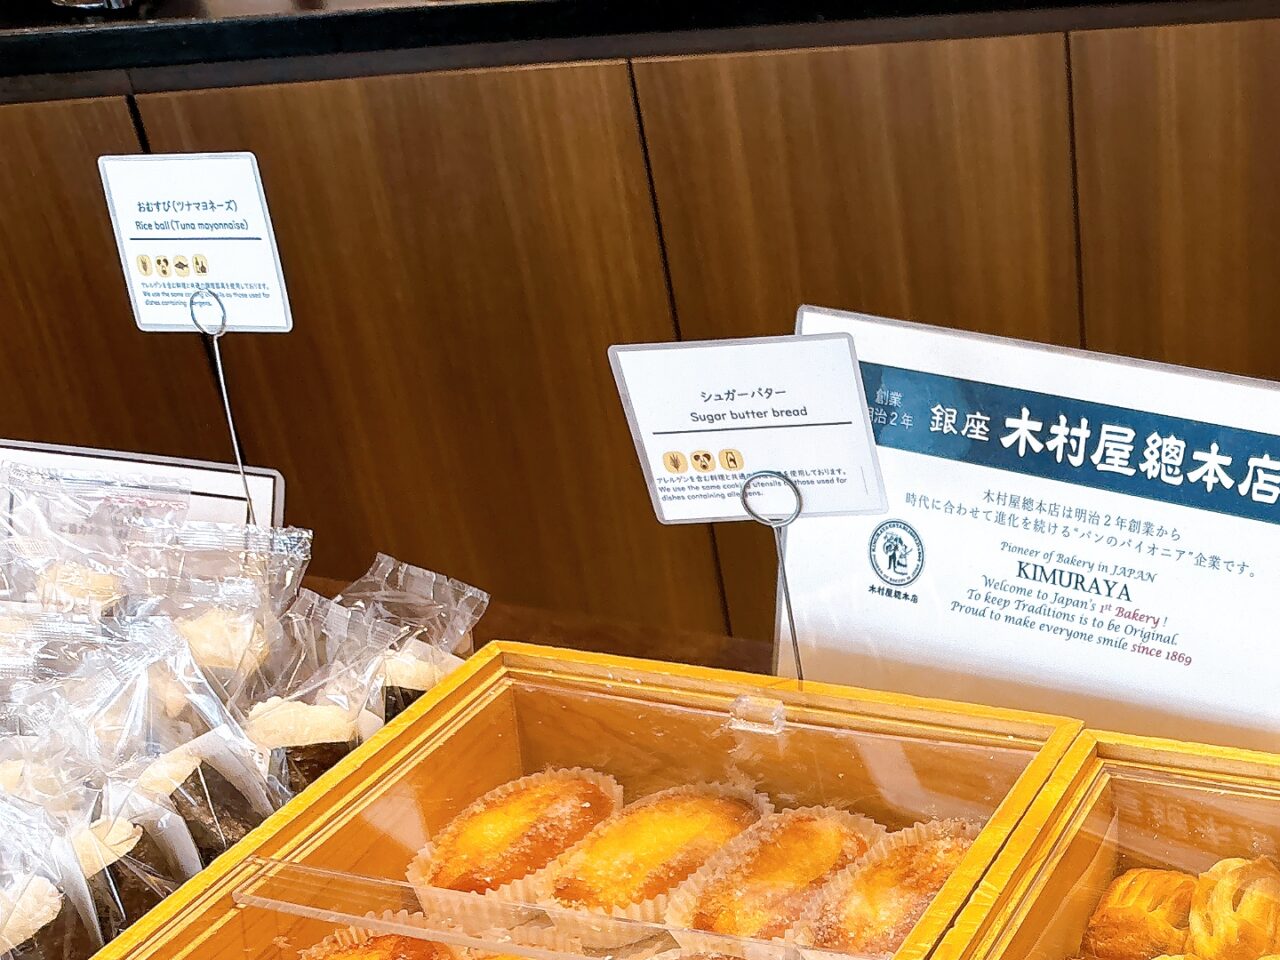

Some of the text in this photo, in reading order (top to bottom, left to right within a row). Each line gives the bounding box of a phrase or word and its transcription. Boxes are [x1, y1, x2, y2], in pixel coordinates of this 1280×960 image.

[135, 221, 153, 230] Rice
[197, 219, 249, 232] mayonnaise)
[690, 406, 808, 424] Sugar butter bread
[700, 387, 787, 403] シュガーバター
[875, 389, 903, 408] 創業
[929, 403, 991, 442] 銀座
[1000, 541, 1158, 583] Pioneer of Bakery in JAPAN
[1016, 560, 1133, 602] KIMURAYA
[966, 588, 1180, 646] To keep Traditions is to be Original.
[981, 574, 1033, 598] Welcome
[1036, 588, 1049, 600] to
[1050, 591, 1096, 612] Japan's
[1099, 602, 1113, 615] 1st
[1114, 605, 1161, 628] Bakery
[950, 600, 1193, 666] Proud to make everyone smile since 1869
